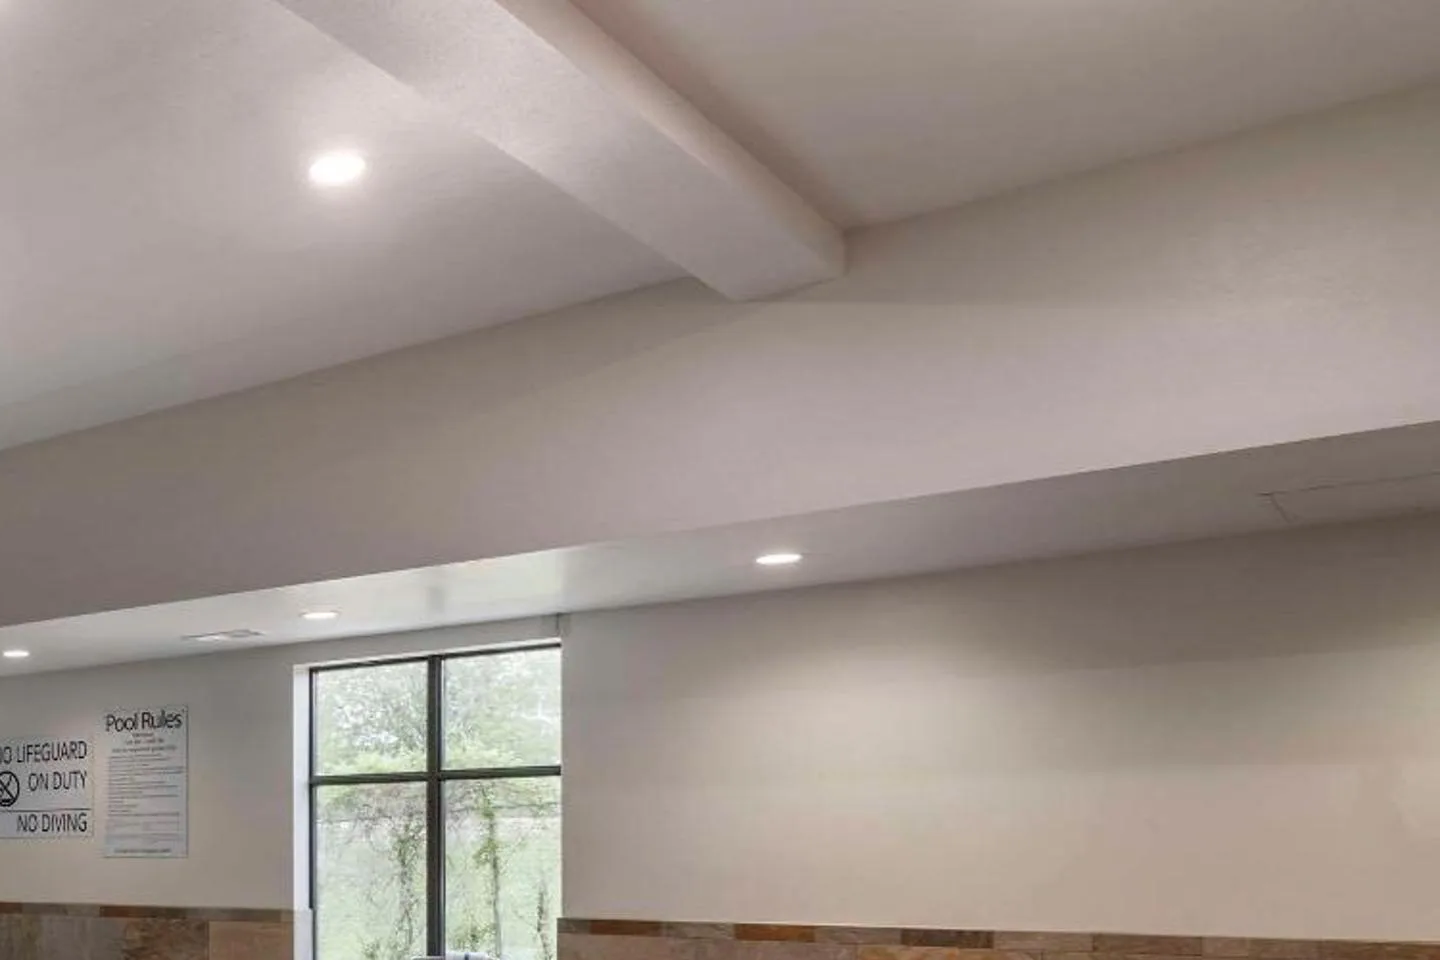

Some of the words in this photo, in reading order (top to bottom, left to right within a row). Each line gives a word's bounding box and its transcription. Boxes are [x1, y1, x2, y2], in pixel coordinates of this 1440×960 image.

[105, 713, 138, 732] Pool
[142, 710, 182, 729] Rules
[17, 741, 87, 763] LIFEGUARD
[28, 773, 49, 792] ON
[53, 770, 87, 790] DUTY
[17, 813, 37, 832] NO
[41, 812, 88, 832] DIVING
